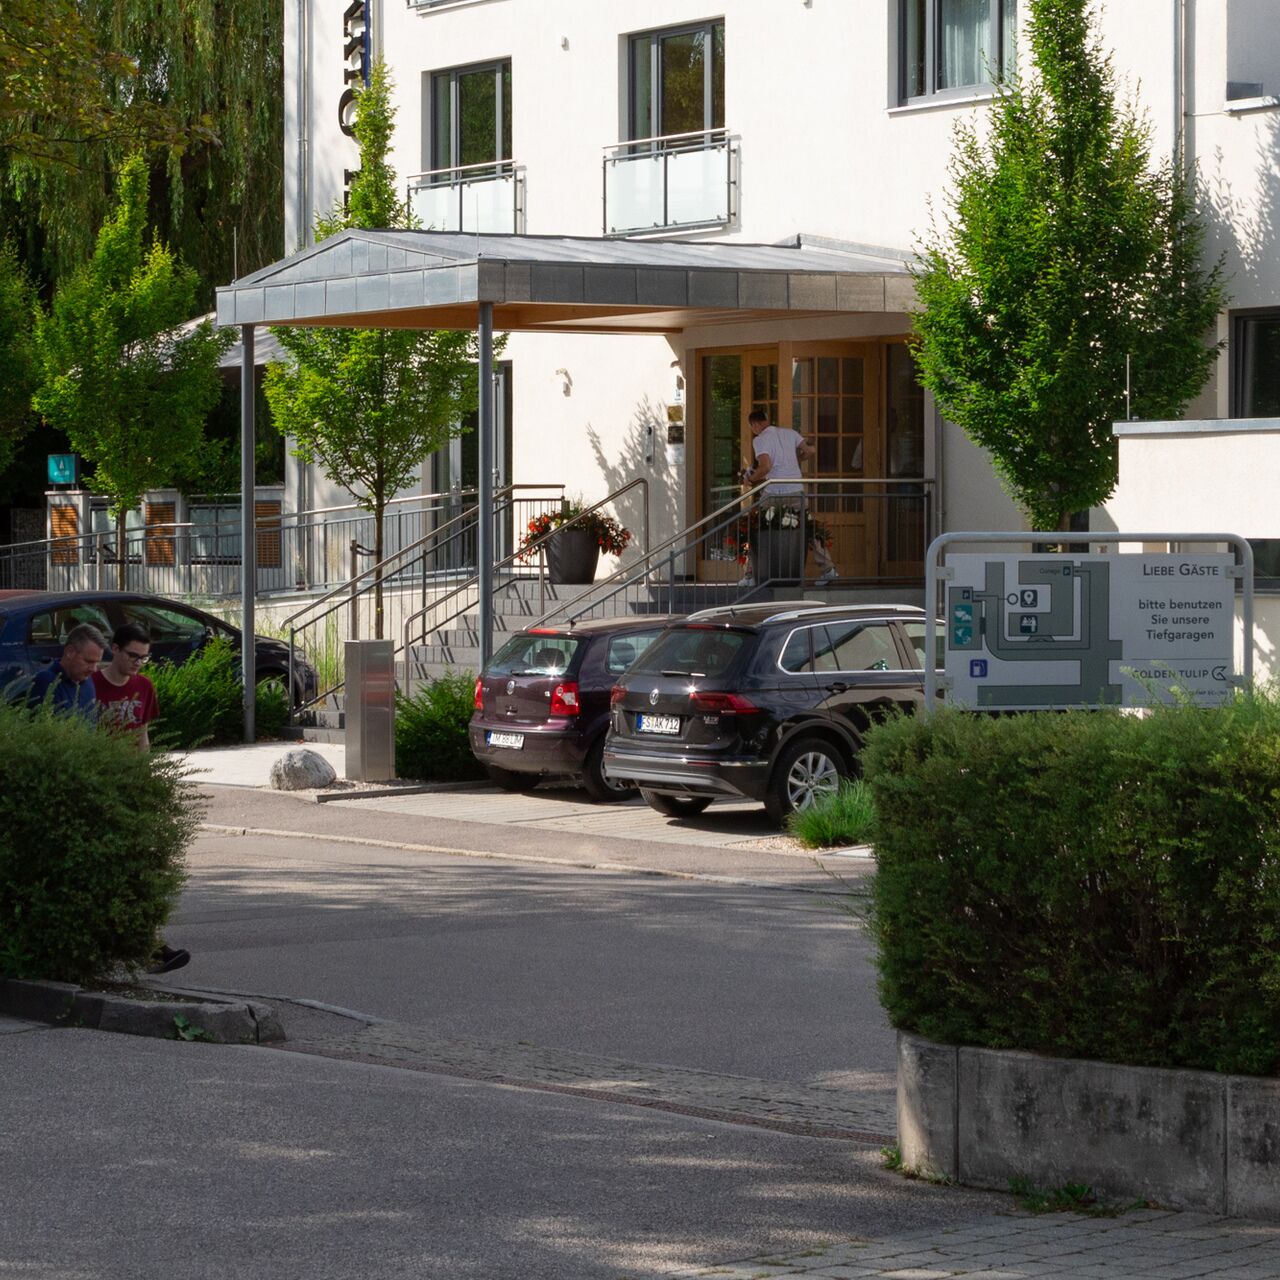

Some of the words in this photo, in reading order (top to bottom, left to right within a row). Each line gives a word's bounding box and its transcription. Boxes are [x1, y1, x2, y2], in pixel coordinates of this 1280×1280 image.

[1143, 564, 1175, 576] LIEBE
[1179, 563, 1219, 576] GÄSTE
[1138, 599, 1166, 610] bitte
[1169, 599, 1222, 610] benutzen
[1151, 614, 1168, 625] Sie
[1172, 616, 1210, 625] unsere
[1146, 629, 1215, 643] Tiefgaragen
[1179, 670, 1209, 679] TULIP
